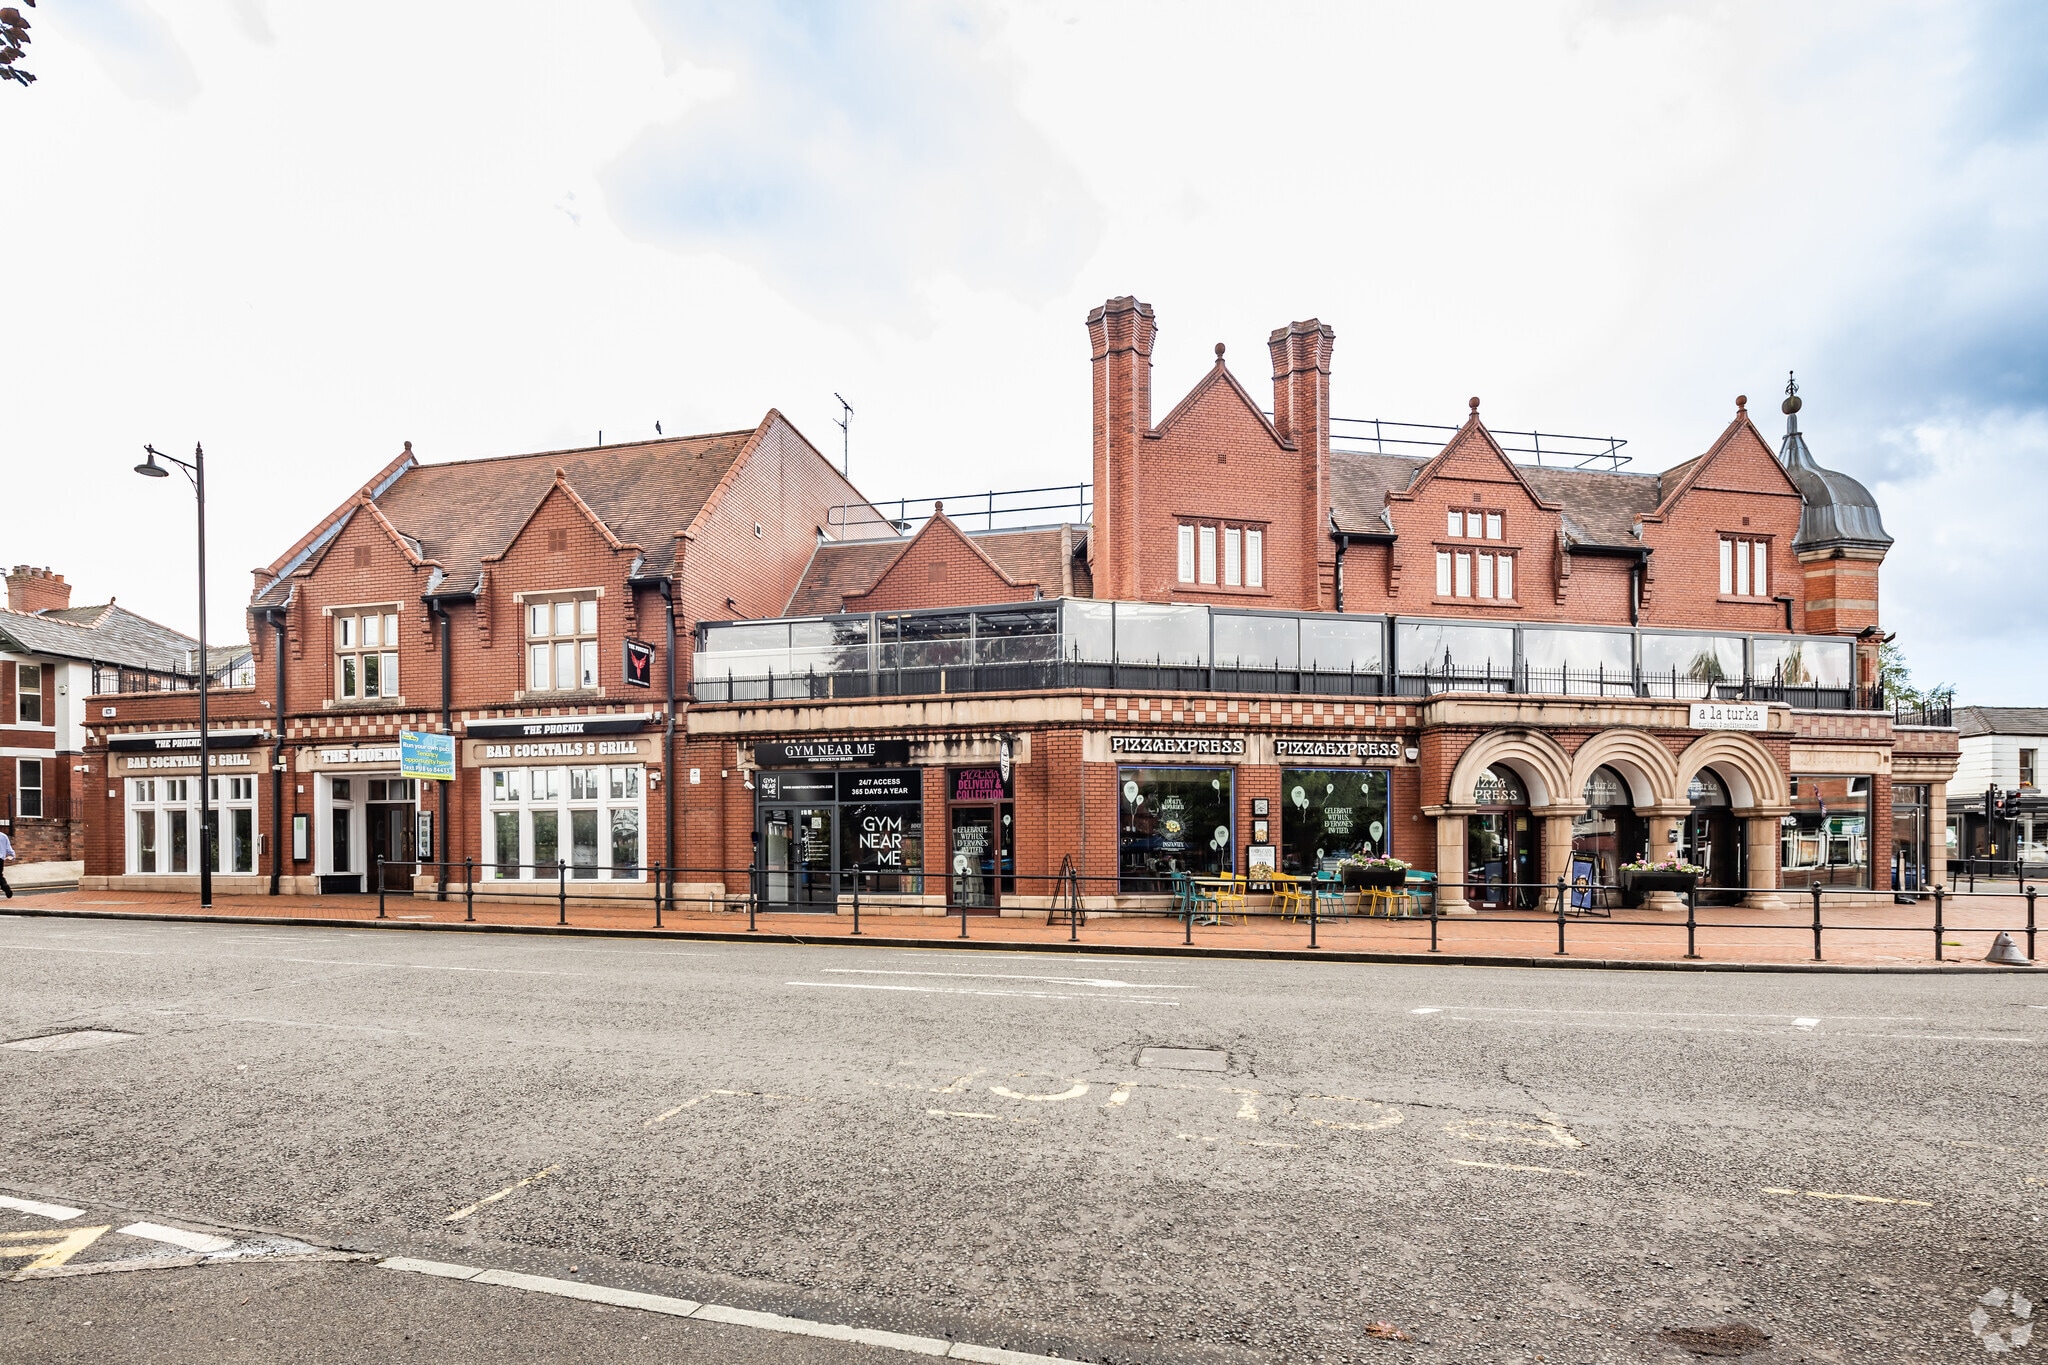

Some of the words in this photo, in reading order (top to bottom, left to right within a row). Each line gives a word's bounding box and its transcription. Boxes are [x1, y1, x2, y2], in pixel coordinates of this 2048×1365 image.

[1699, 709, 1705, 719] a
[1710, 706, 1722, 719] la
[1727, 707, 1758, 720] turka
[524, 725, 542, 735] THE
[544, 724, 584, 734] PHOENIX
[155, 739, 170, 748] THE
[486, 745, 511, 758] BAR
[514, 743, 583, 757] COCKTAILS
[586, 742, 595, 755] &
[599, 741, 637, 754] GRILL
[785, 745, 813, 756] GYM
[818, 744, 852, 755] NEAR
[857, 743, 876, 754] ME
[1113, 738, 1243, 753] PIZZAEXPRESS
[1276, 741, 1399, 755] PIZZAEXPRESS
[127, 757, 148, 769] BAR
[209, 755, 216, 766] &
[218, 753, 251, 766] GRILL
[321, 749, 348, 763] THE
[960, 769, 999, 779] PIZZERIA
[958, 779, 994, 789] DELIVERY
[995, 779, 1002, 789] &
[1477, 778, 1506, 788] IZZA
[956, 789, 1004, 800] COLLECTION
[1475, 790, 1518, 800] PRESS
[863, 816, 901, 831] GYM
[860, 833, 902, 848] NEAR
[878, 851, 901, 865] ME
